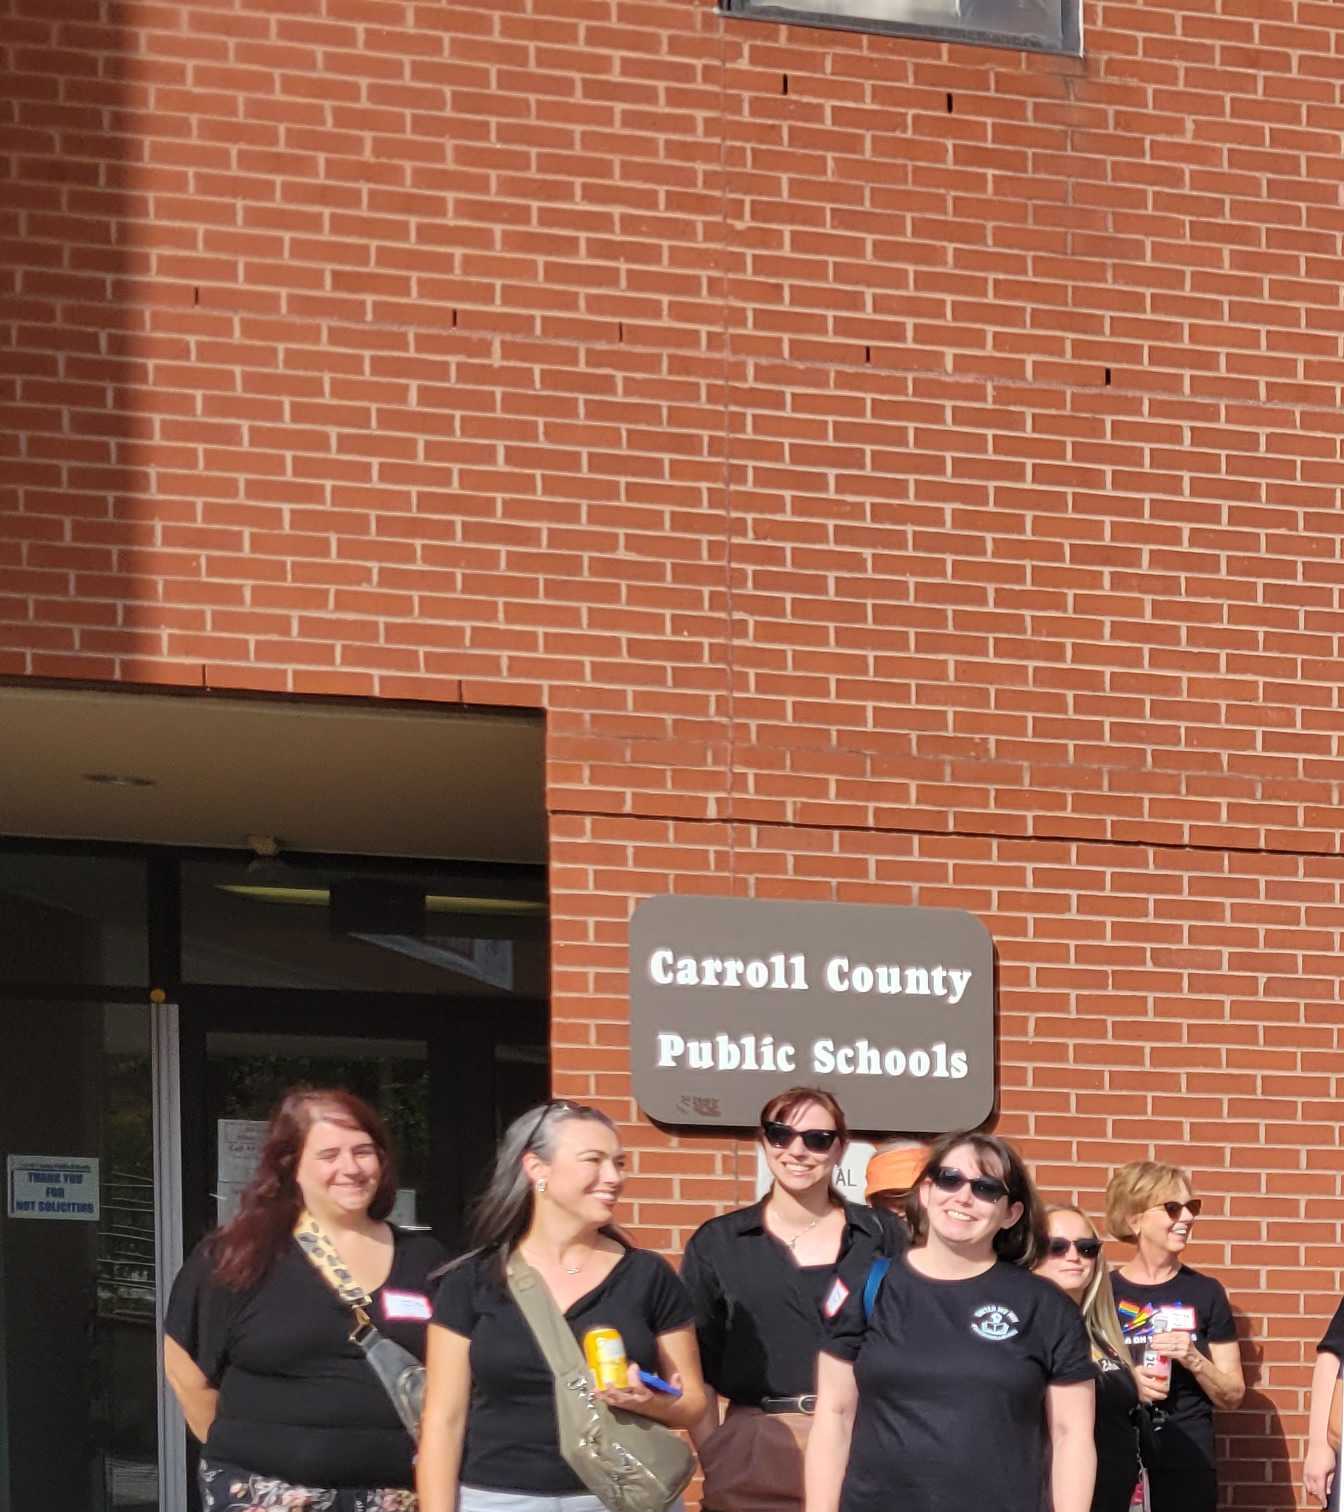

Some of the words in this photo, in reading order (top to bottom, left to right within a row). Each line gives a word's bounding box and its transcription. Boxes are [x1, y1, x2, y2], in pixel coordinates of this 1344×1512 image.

[649, 948, 809, 990] Carroll
[826, 955, 972, 1004] County
[656, 1032, 797, 1073] Public
[813, 1037, 968, 1080] Schools
